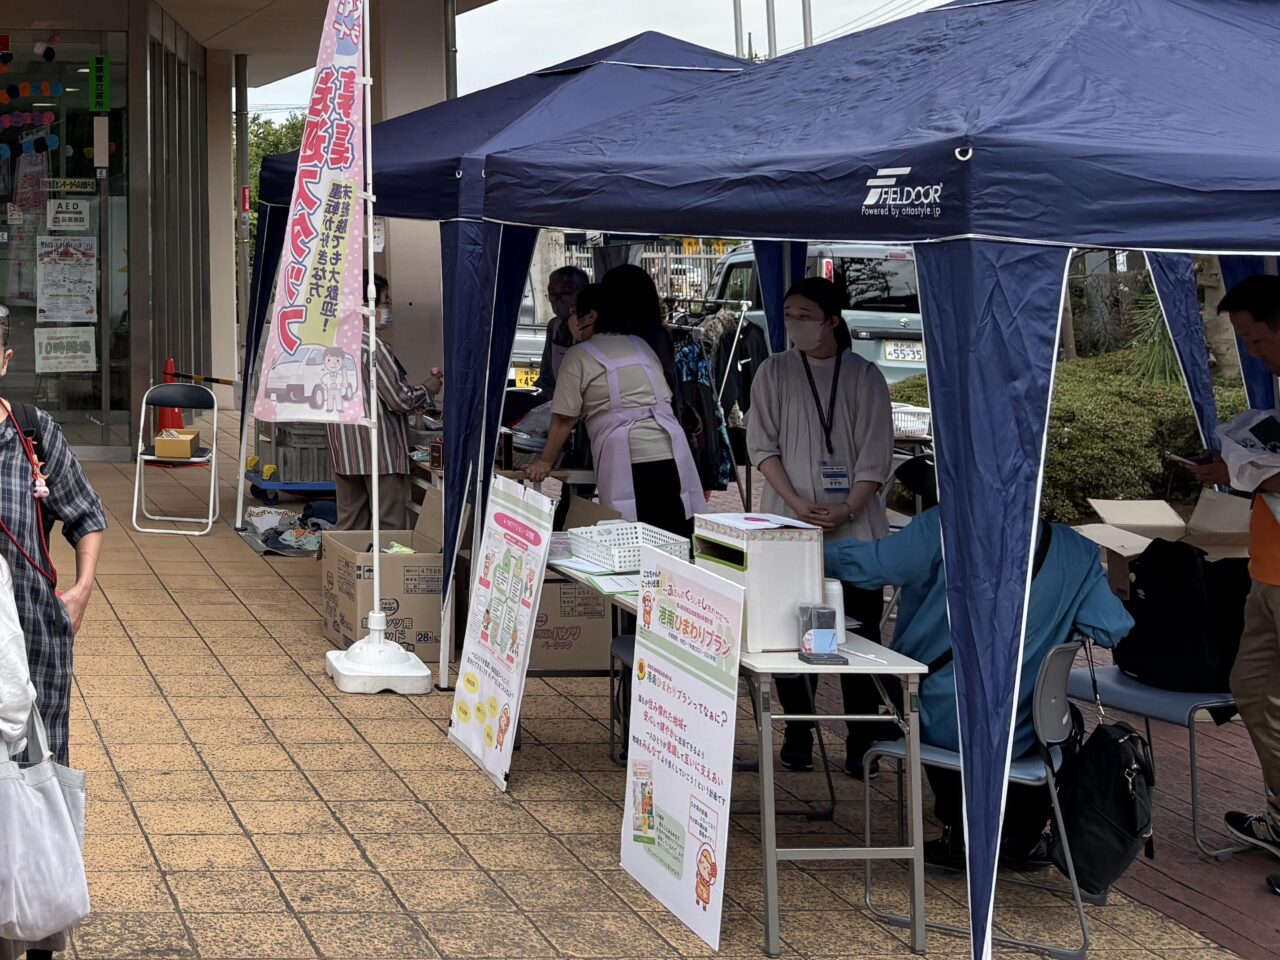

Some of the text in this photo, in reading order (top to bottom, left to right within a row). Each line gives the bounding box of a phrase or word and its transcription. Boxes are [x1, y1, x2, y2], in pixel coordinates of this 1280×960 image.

[866, 185, 942, 205] FIELDOOR
[57, 202, 79, 210] AED
[861, 205, 889, 215] Powered
[891, 205, 900, 218] by
[659, 605, 732, 657] 港南ひまわりプラン
